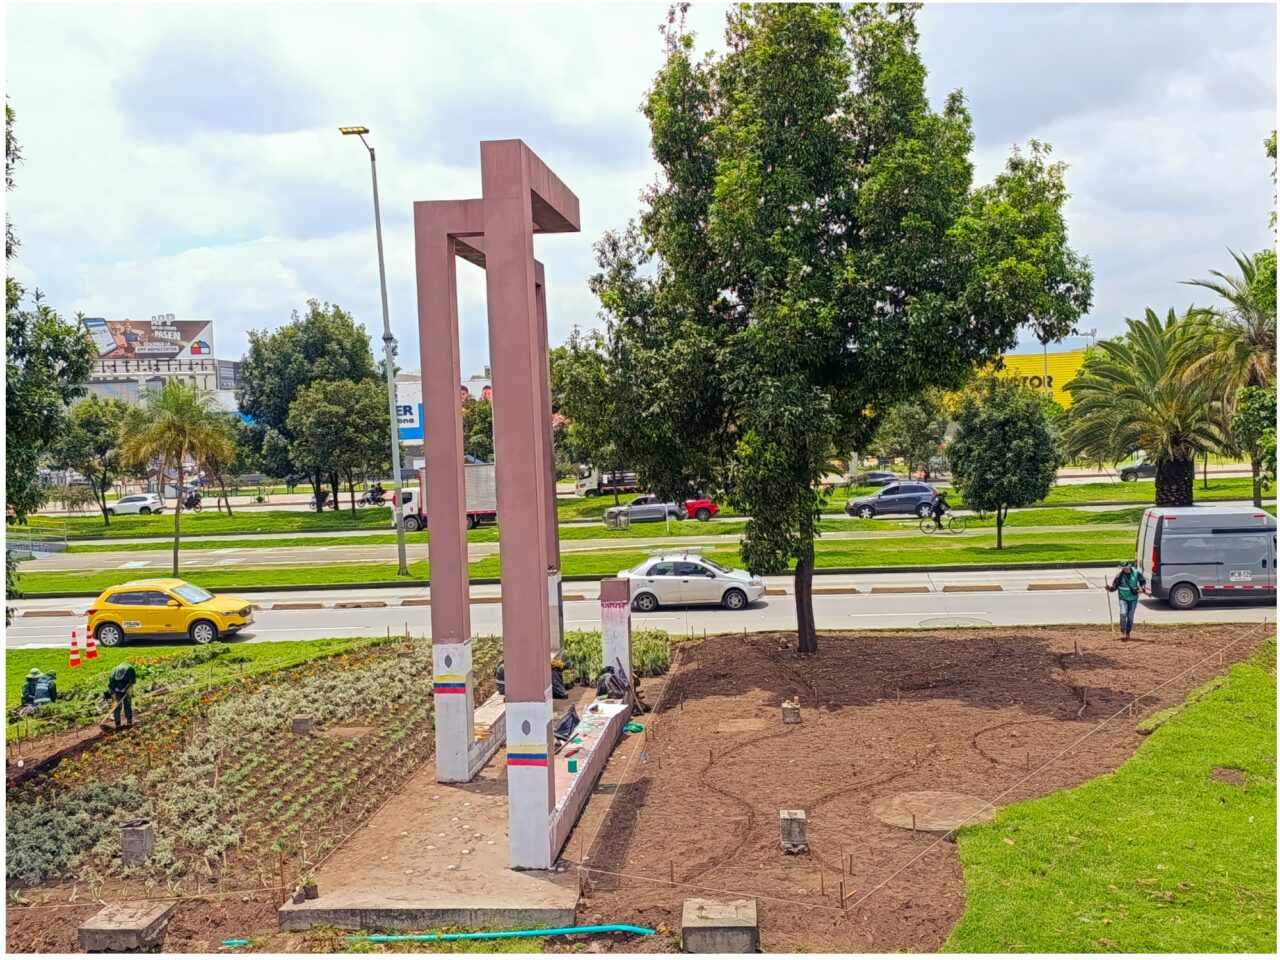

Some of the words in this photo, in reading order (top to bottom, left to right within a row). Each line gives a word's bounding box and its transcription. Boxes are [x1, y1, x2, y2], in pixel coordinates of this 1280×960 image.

[150, 313, 176, 326] APP
[154, 330, 181, 340] PASEN
[395, 405, 413, 416] ER
